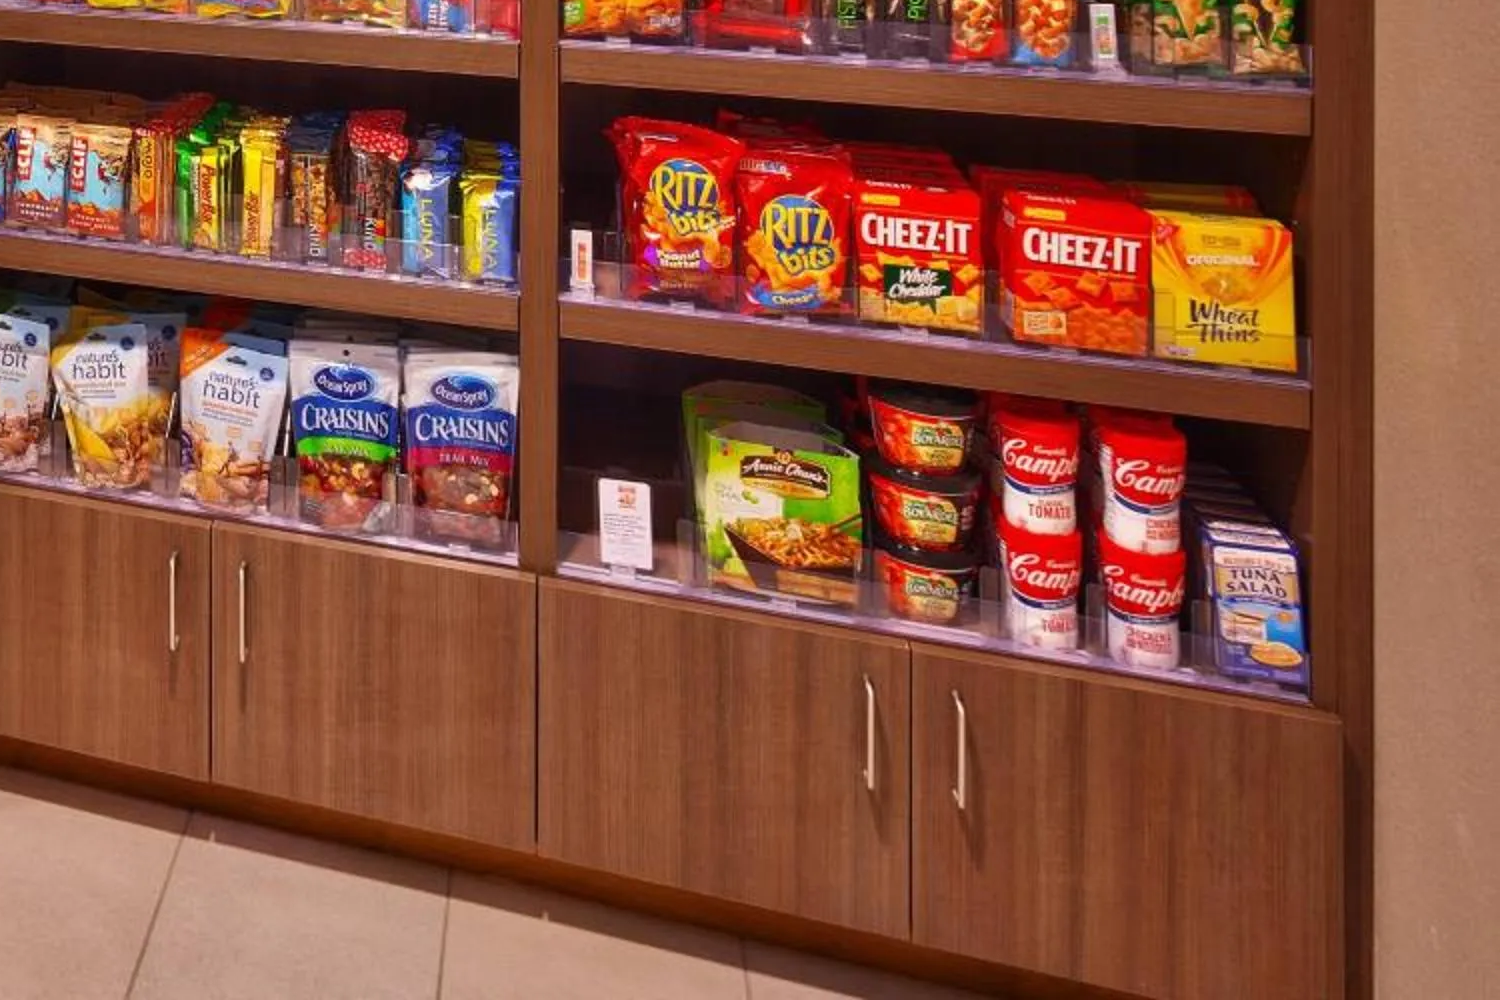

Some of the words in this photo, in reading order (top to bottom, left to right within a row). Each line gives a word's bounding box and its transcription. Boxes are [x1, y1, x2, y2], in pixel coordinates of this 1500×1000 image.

[651, 162, 718, 209] RITZ
[419, 198, 434, 260] LUNA
[669, 207, 720, 236] bits
[762, 200, 833, 246] RITZ
[861, 212, 973, 255] CHEEZ-IT
[308, 222, 322, 257] KIND
[1022, 226, 1142, 274] CHEEZ-IT
[779, 244, 836, 276] bits
[898, 266, 939, 284] White
[888, 282, 948, 299] Cheddar
[1189, 299, 1259, 327] Wheat
[1185, 323, 1264, 344] Thins
[72, 360, 127, 380] habit
[203, 381, 262, 409] habit
[301, 404, 389, 440] CRAISINS
[414, 412, 509, 446] CRAISINS
[1225, 582, 1288, 599] SALAD
[1229, 568, 1282, 586] TUNA
